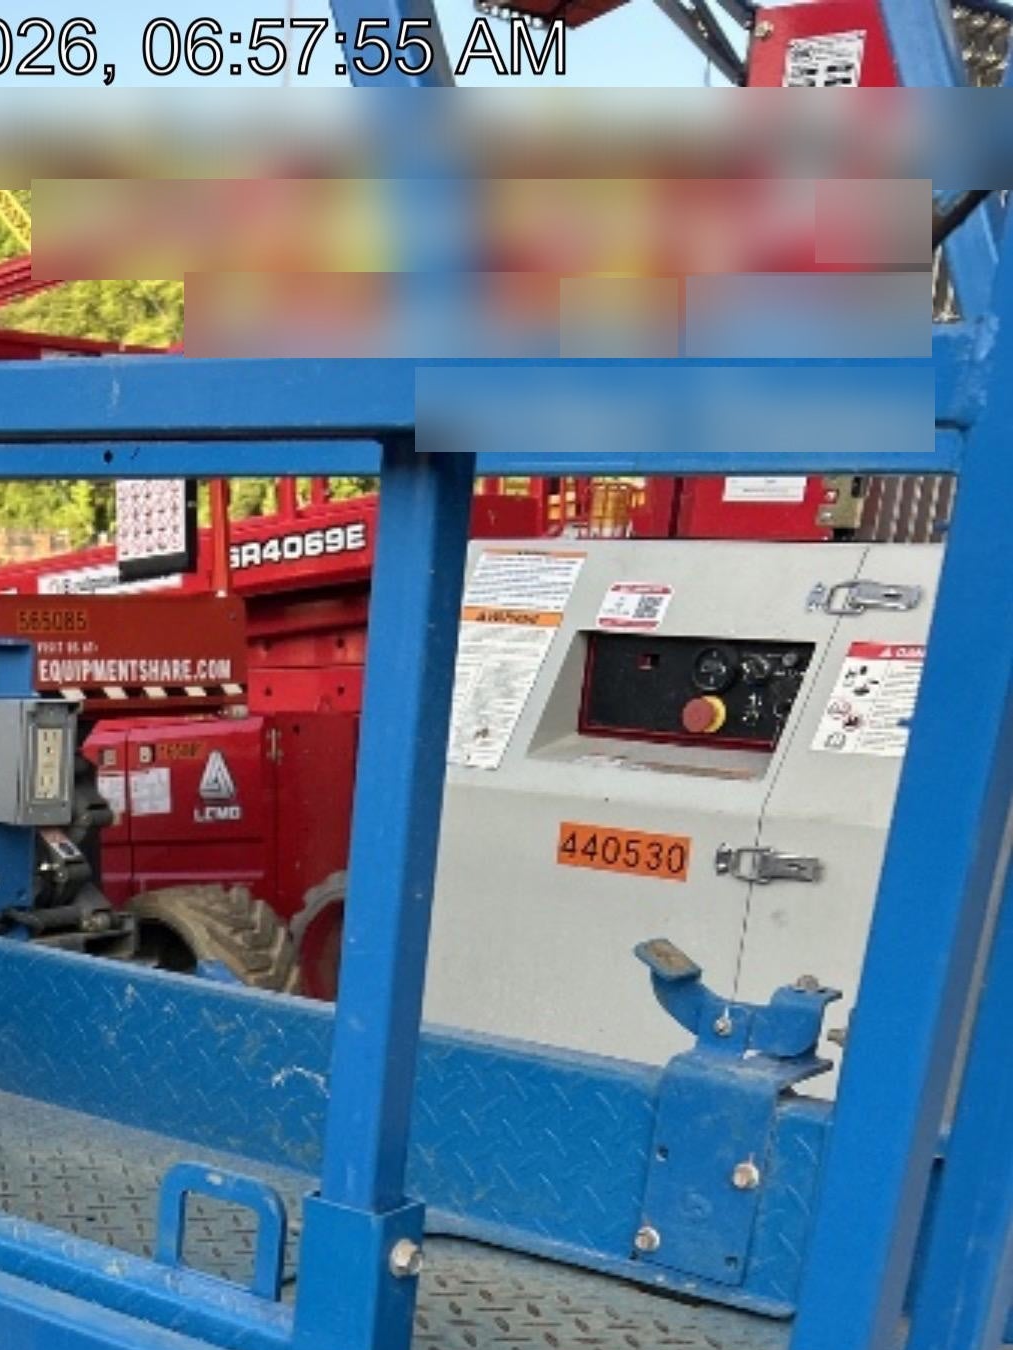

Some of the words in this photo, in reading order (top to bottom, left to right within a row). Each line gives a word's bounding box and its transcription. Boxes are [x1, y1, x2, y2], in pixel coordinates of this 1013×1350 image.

[18, 611, 87, 631] 565085
[39, 659, 232, 684] EQUIPMENTSHARE.COM
[561, 831, 685, 873] 440530
